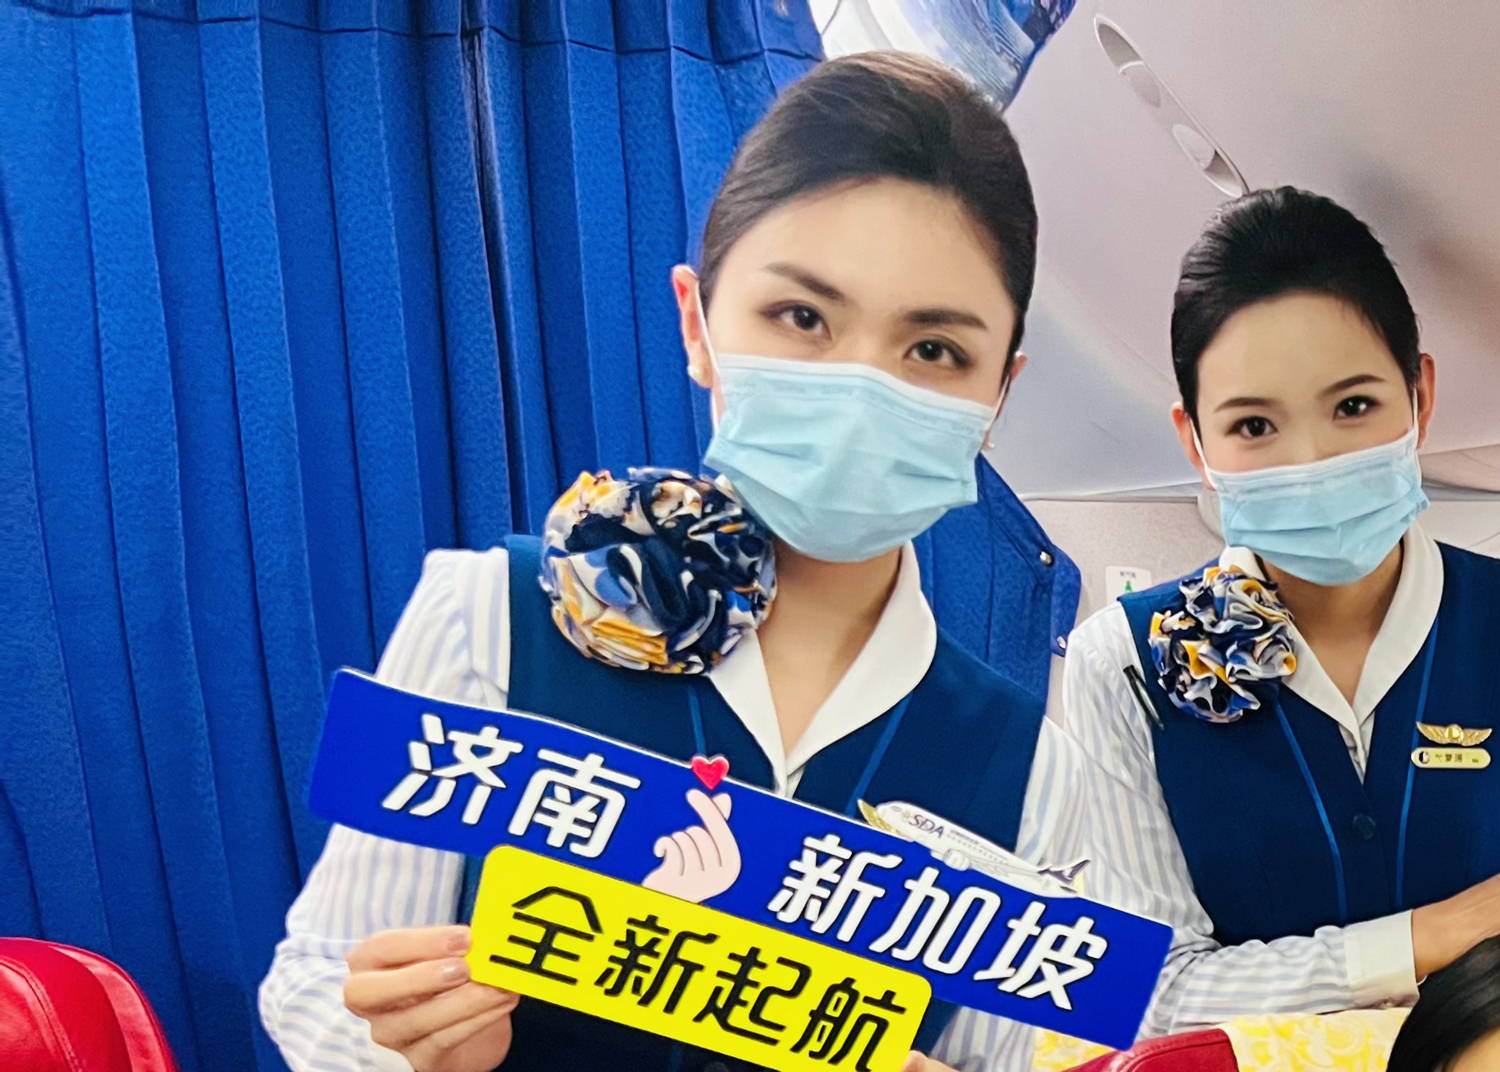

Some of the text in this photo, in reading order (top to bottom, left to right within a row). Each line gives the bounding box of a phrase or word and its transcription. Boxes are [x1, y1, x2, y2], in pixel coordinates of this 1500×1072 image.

[382, 714, 1107, 1011] 济南 新加坡
